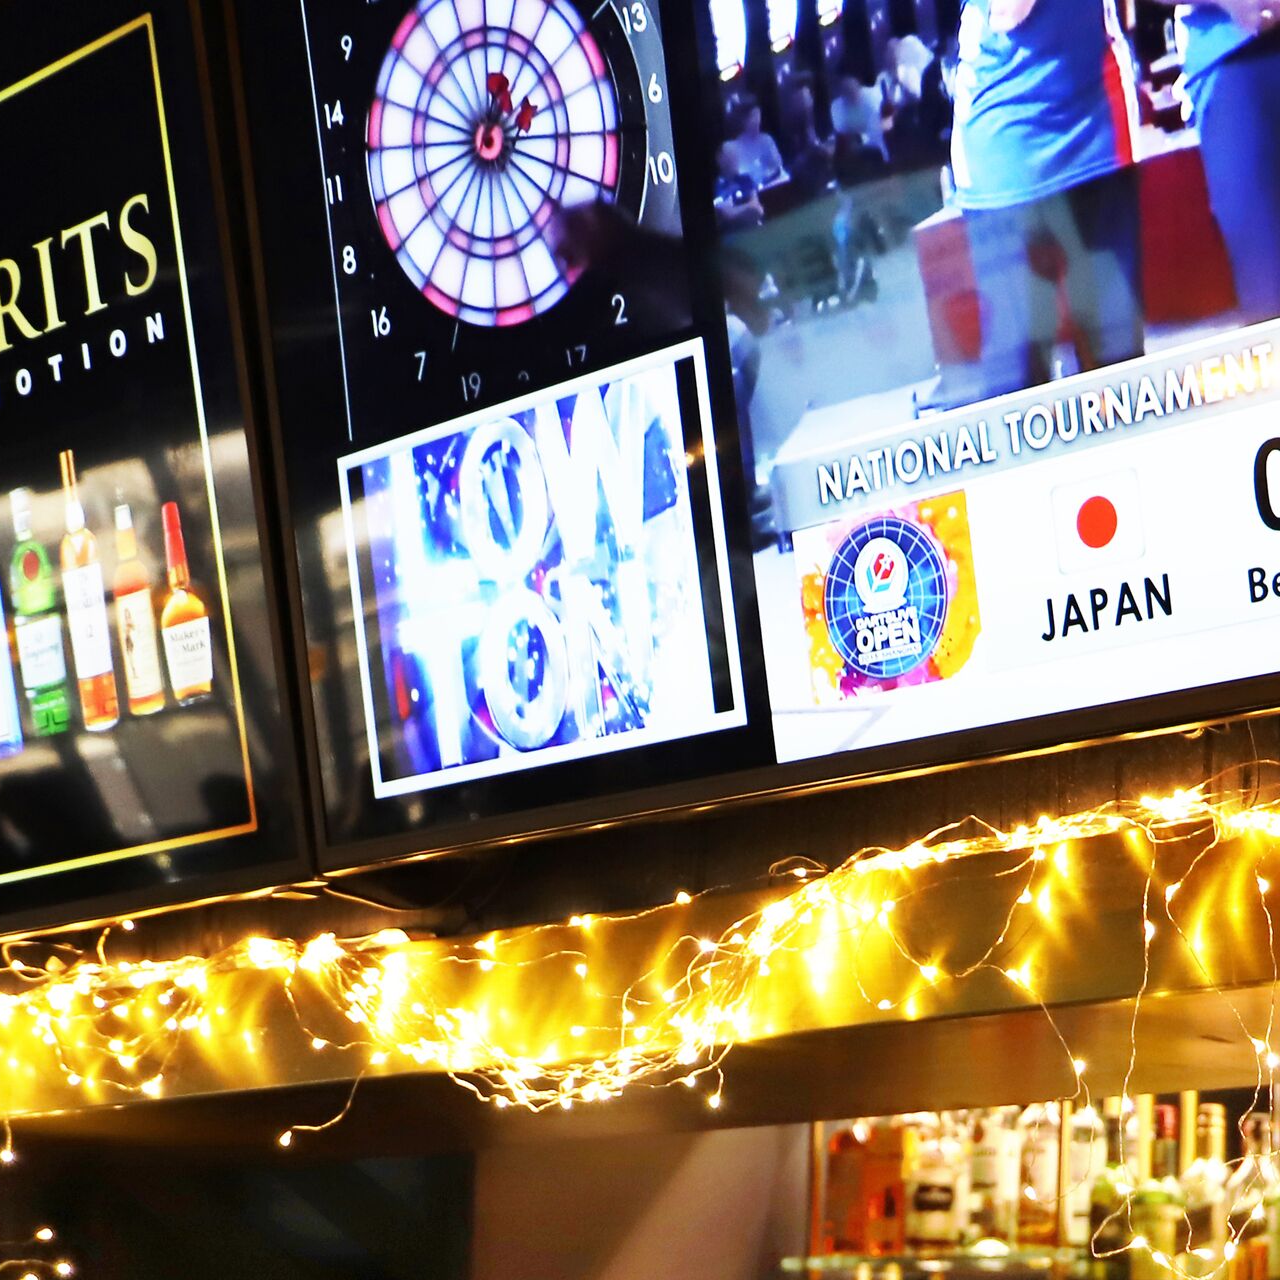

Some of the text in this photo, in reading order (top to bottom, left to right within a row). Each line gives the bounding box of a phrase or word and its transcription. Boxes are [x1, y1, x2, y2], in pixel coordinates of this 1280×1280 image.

[622, 2, 649, 34] 13
[340, 34, 354, 62] 9
[647, 72, 663, 105] 6
[323, 99, 345, 130] 14
[647, 152, 676, 186] 10
[326, 175, 344, 205] 11
[342, 245, 357, 275] 8
[371, 306, 391, 338] 16
[610, 293, 628, 326] 2
[413, 350, 428, 382] 7
[565, 344, 588, 367] 17
[460, 371, 482, 402] 19
[817, 341, 1275, 506] NATIONAL TOURNAMENT
[1040, 573, 1174, 643] JAPAN
[856, 618, 922, 655] OPEN
